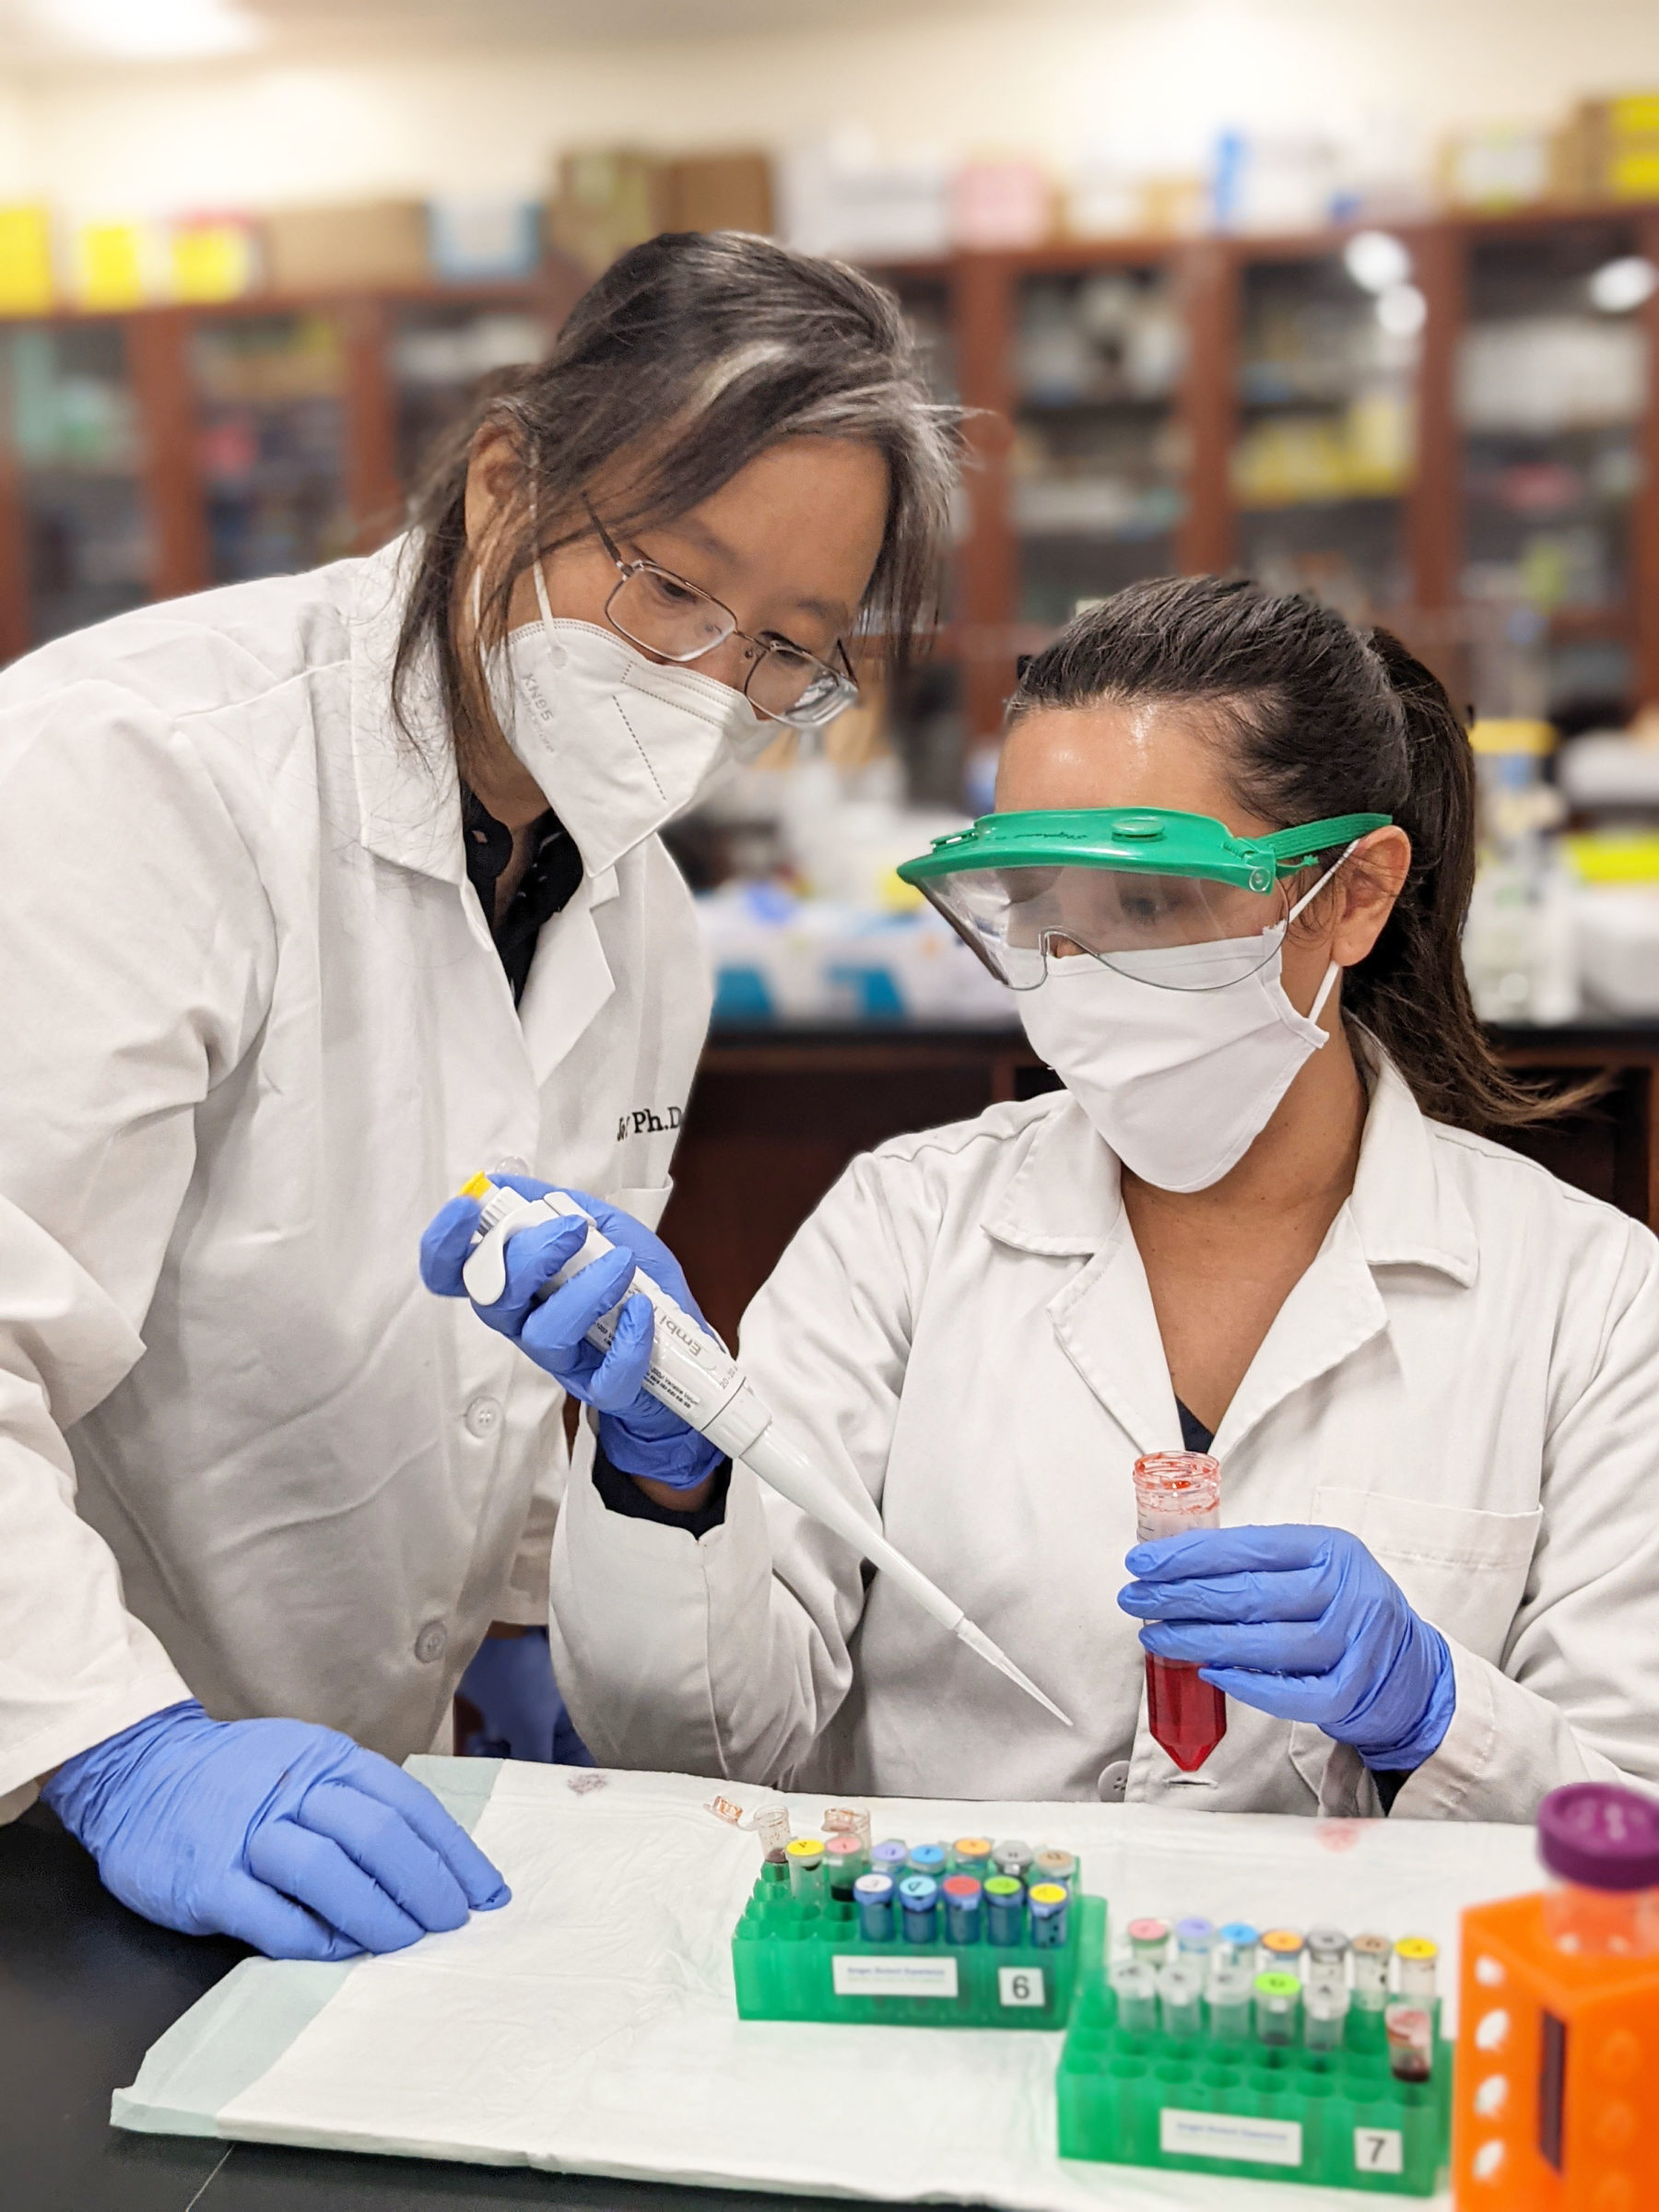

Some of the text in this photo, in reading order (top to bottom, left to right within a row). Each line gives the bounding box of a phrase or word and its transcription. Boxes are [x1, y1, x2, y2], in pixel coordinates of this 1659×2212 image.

[524, 673, 554, 721] KN95
[1011, 1975, 1030, 2000] 6
[1367, 2136, 1387, 2165] 7
